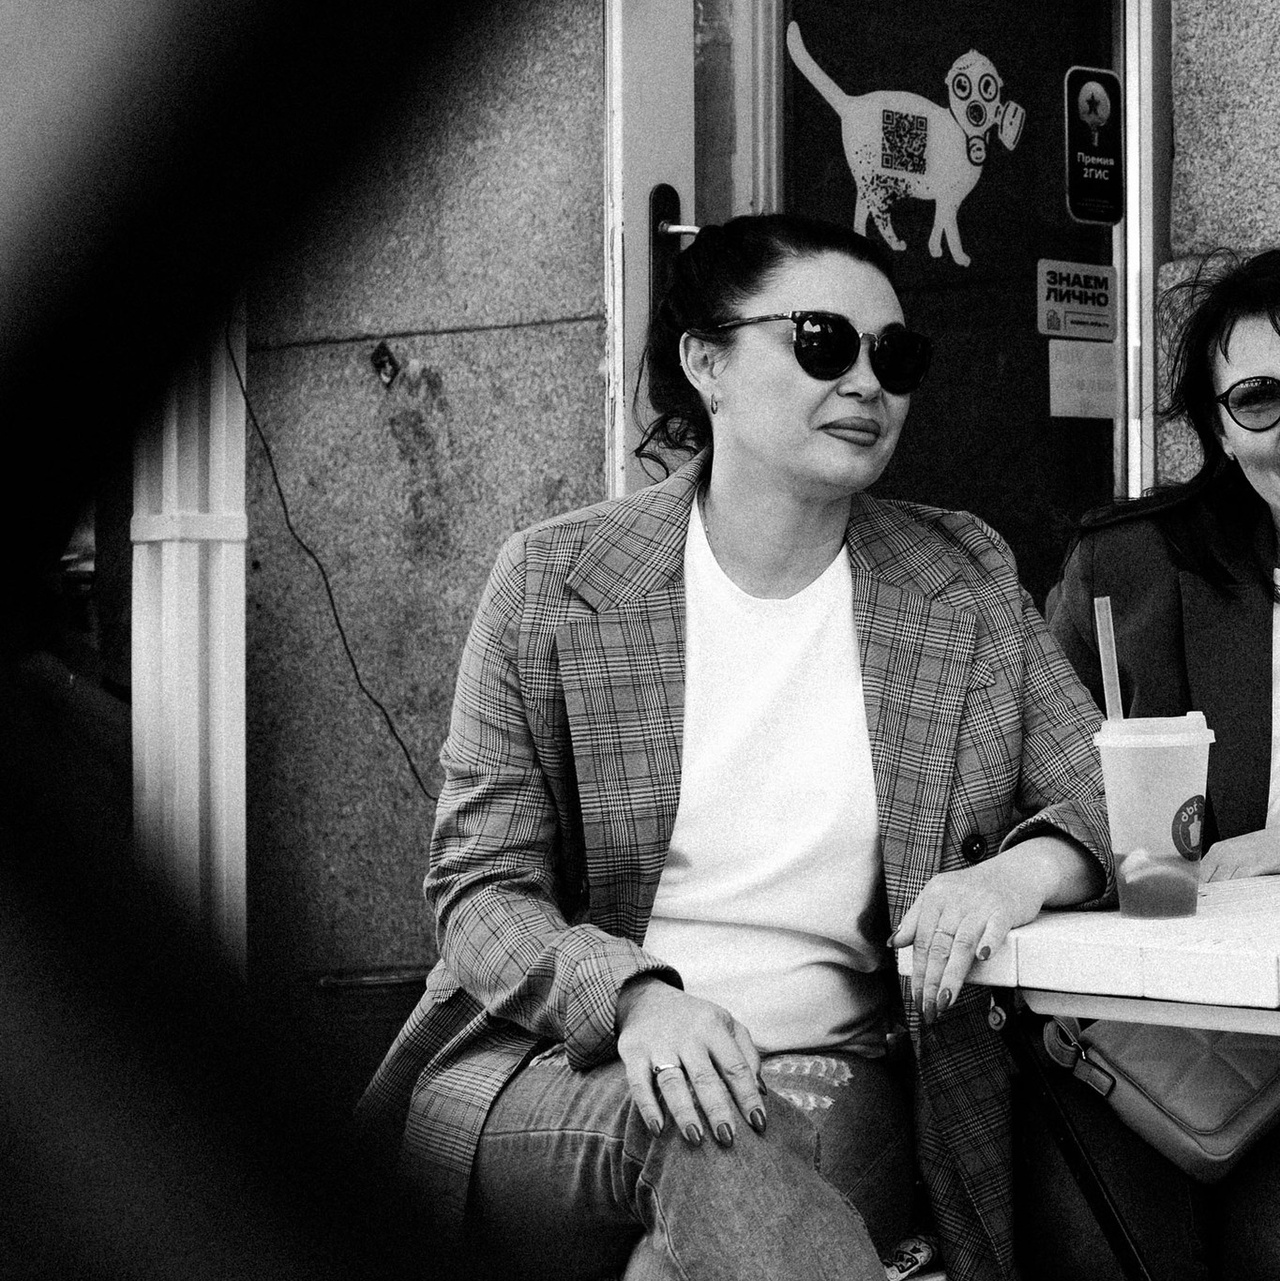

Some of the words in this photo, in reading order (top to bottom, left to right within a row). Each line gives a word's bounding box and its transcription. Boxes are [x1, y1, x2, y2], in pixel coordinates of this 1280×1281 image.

[1076, 151, 1115, 167] Премия
[1082, 167, 1110, 181] 2ГИС
[1045, 270, 1109, 291] ЗНАЕМ
[1045, 287, 1109, 308] ЛИЧНО
